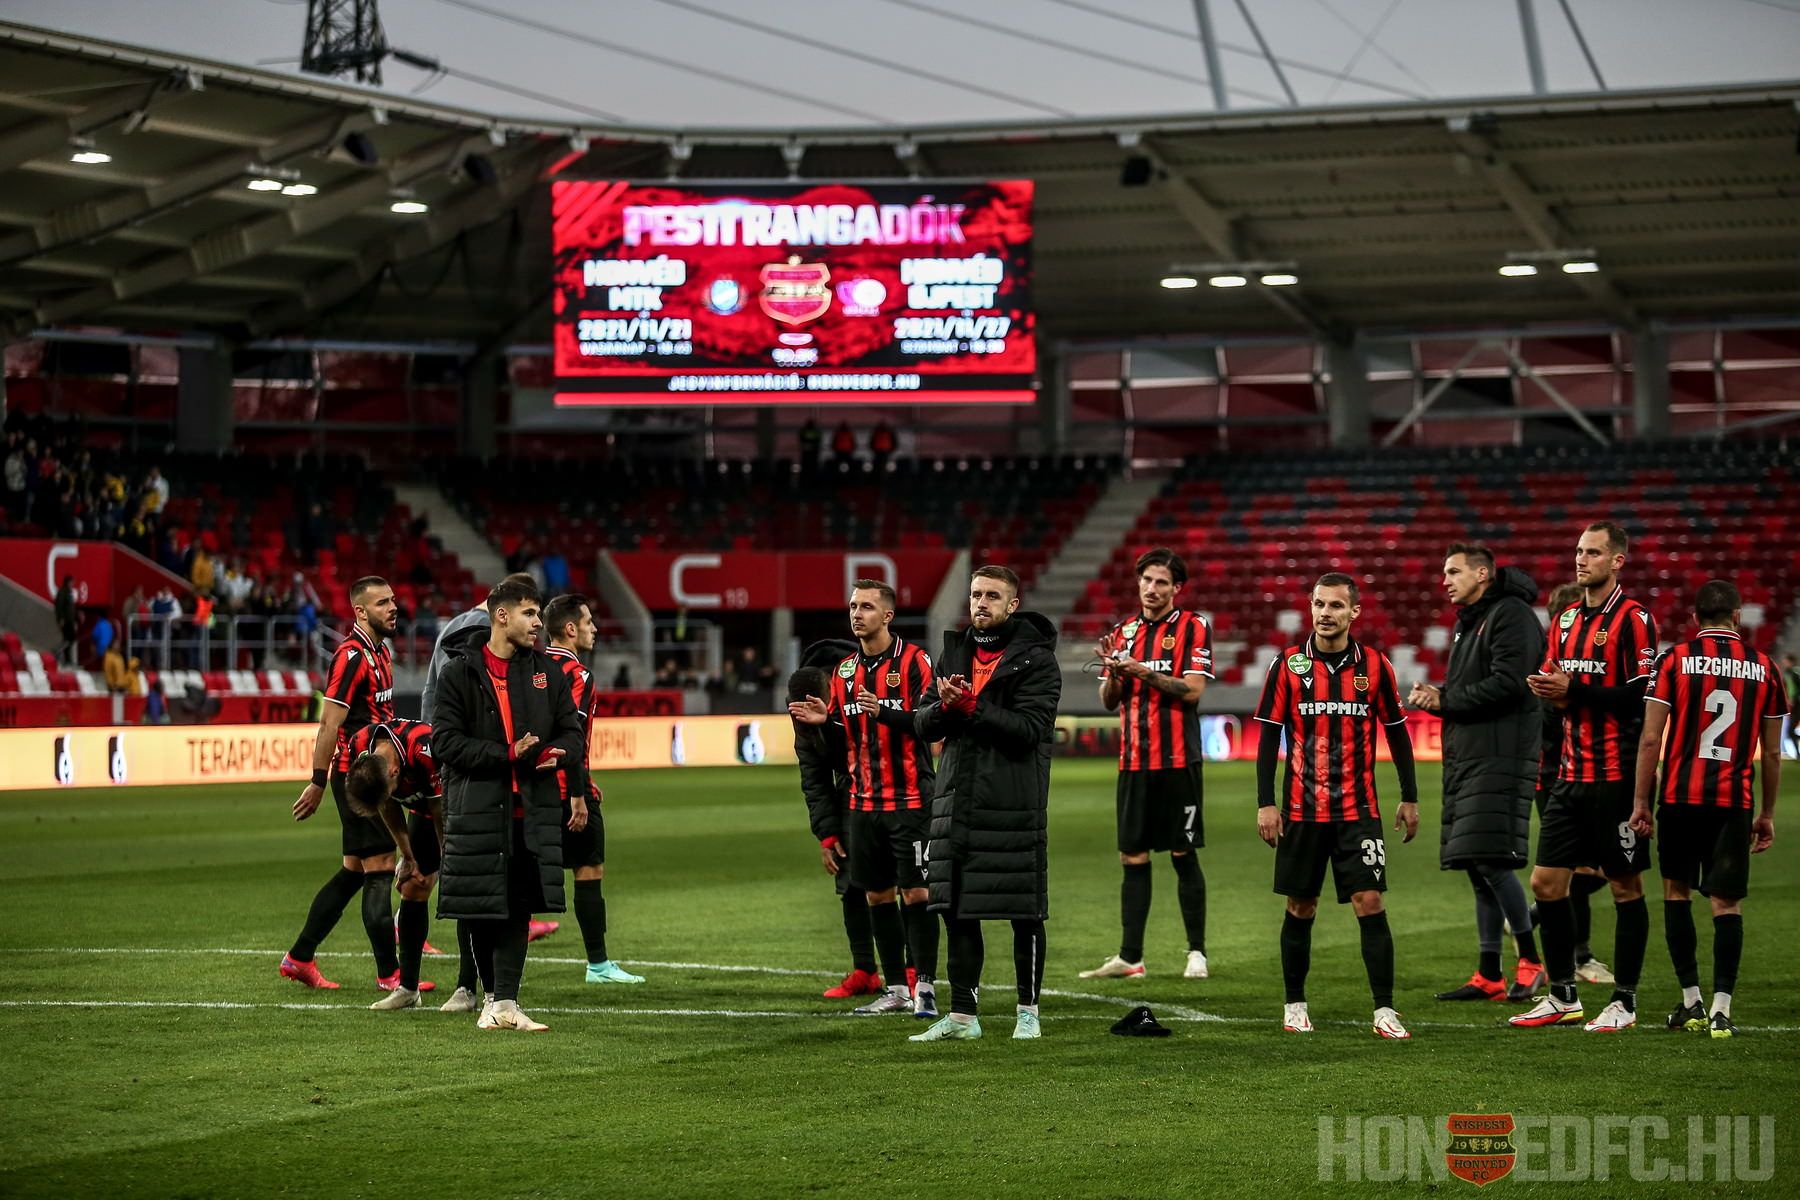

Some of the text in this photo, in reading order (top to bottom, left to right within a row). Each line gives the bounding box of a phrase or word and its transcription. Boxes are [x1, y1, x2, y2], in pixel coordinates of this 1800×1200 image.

[669, 554, 721, 607] C
[1681, 656, 1765, 682] MEZGHRANI
[1698, 689, 1737, 762] 2
[1184, 805, 1197, 830] 7
[1618, 821, 1636, 849] 9
[1361, 838, 1386, 866] 35
